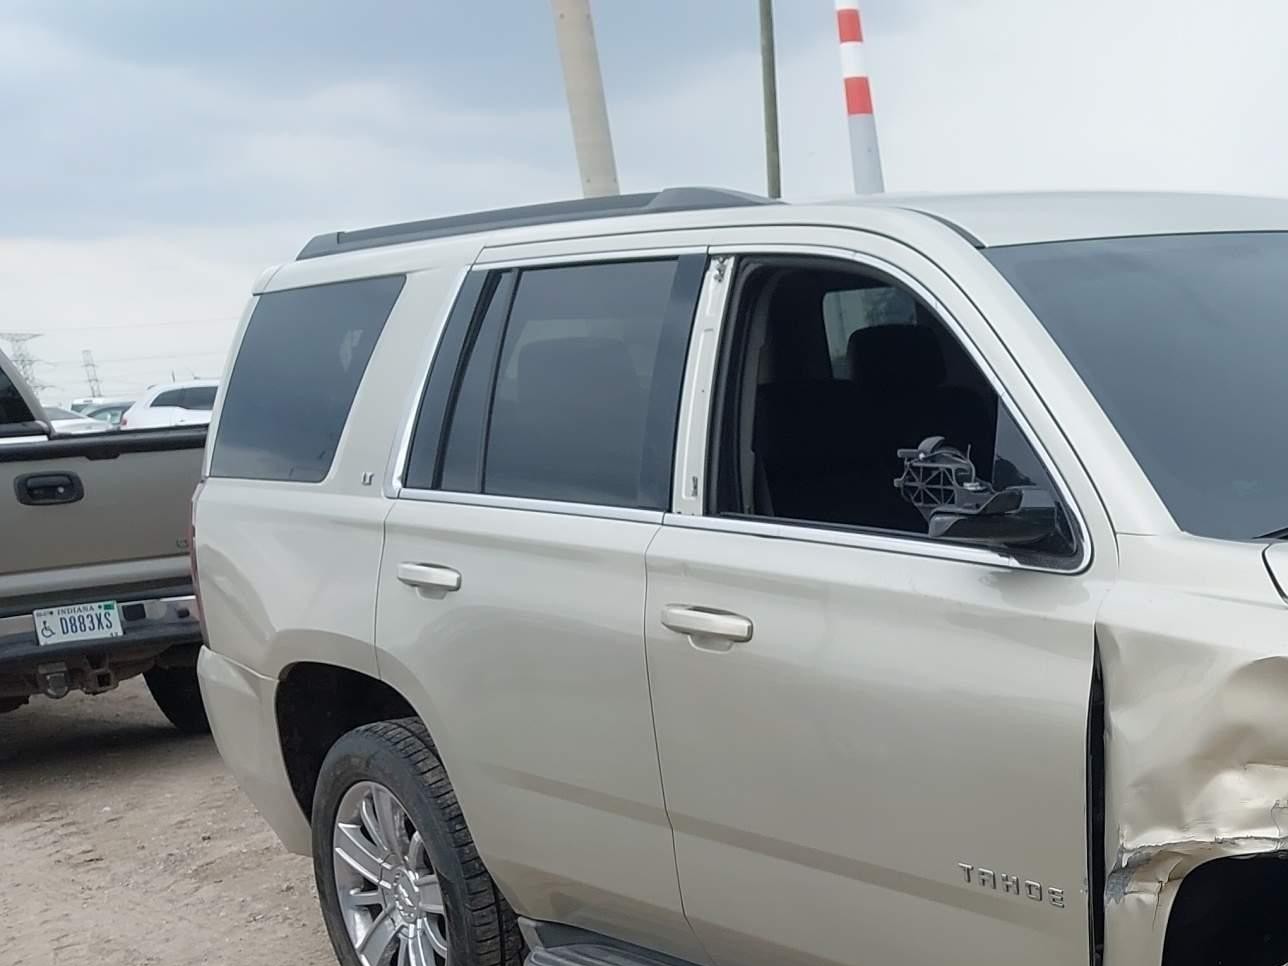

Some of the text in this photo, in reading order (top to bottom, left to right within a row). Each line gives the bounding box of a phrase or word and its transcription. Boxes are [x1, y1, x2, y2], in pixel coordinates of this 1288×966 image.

[57, 605, 94, 615] INDIANA
[60, 611, 113, 635] D883XS
[957, 861, 1065, 908] TAHOE
